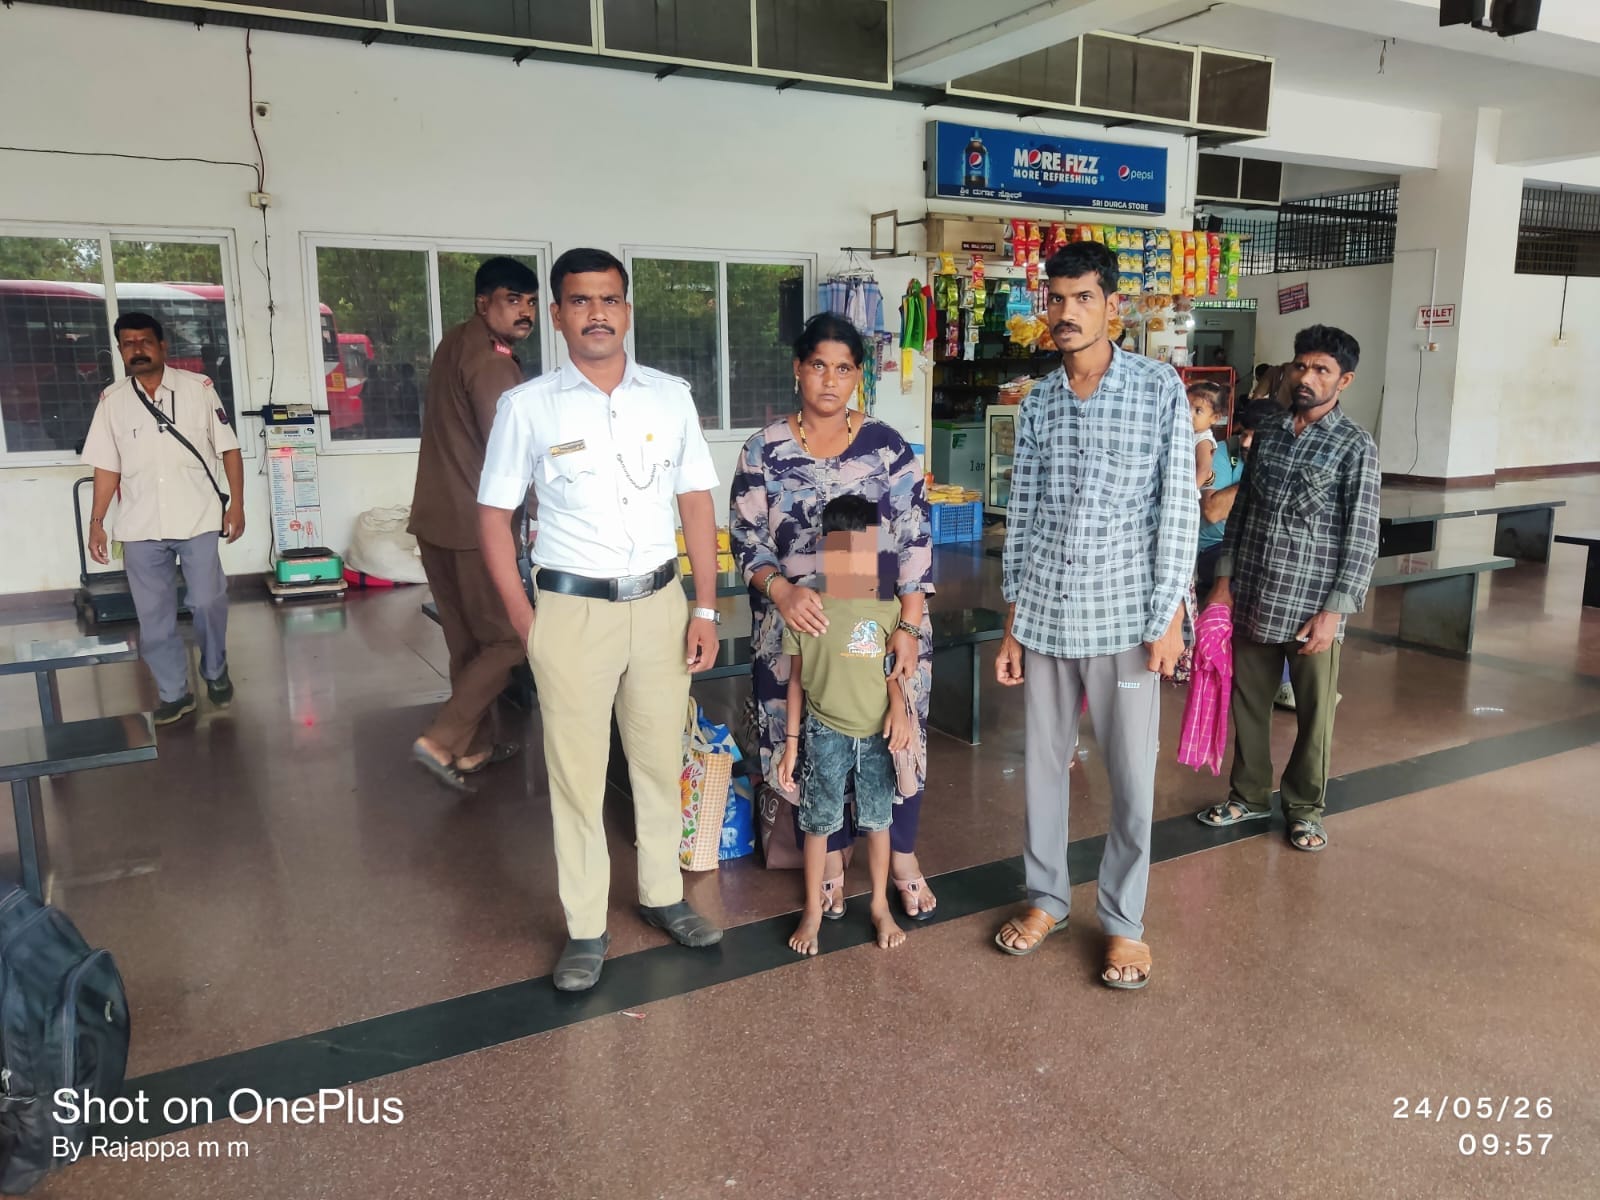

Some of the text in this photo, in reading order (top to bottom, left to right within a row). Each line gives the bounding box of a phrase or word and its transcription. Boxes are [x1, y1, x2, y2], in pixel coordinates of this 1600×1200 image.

[1013, 148, 1098, 174] MORE FIZZ
[1013, 168, 1098, 185] MORE REFRESHING
[1130, 170, 1153, 181] pepsi
[1092, 199, 1149, 210] SRI DURGA STORE
[1421, 308, 1453, 318] TOILET
